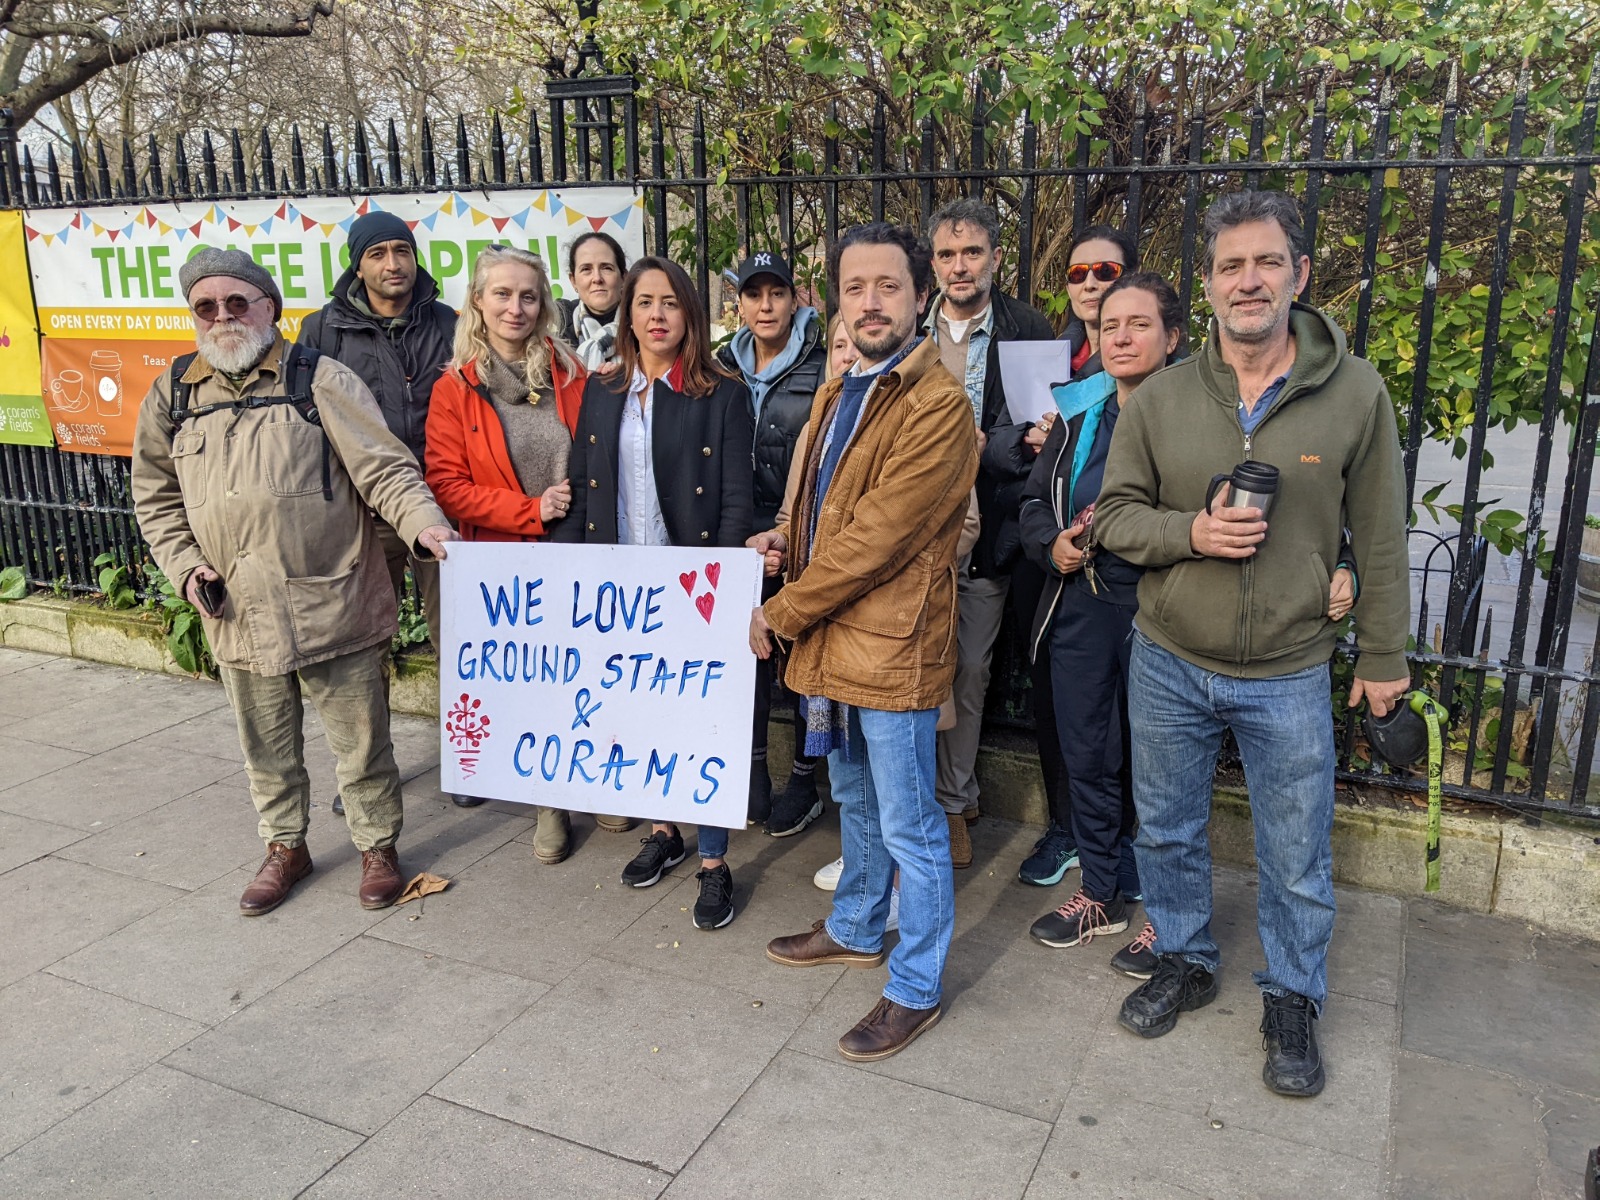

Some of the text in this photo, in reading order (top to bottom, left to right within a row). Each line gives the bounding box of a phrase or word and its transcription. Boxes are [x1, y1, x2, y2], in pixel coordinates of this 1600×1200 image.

[754, 252, 771, 267] NY
[91, 246, 174, 298] THE
[50, 314, 196, 330] OPEN EVERY DAY DURIN
[6, 406, 41, 419] coram's
[9, 418, 34, 433] fields
[70, 422, 107, 435] coram's
[75, 433, 102, 447] fields
[479, 575, 666, 634] WE LOVE
[457, 639, 727, 699] GROUND STAFF
[571, 687, 603, 731] &
[512, 731, 726, 805] CORAM'S
